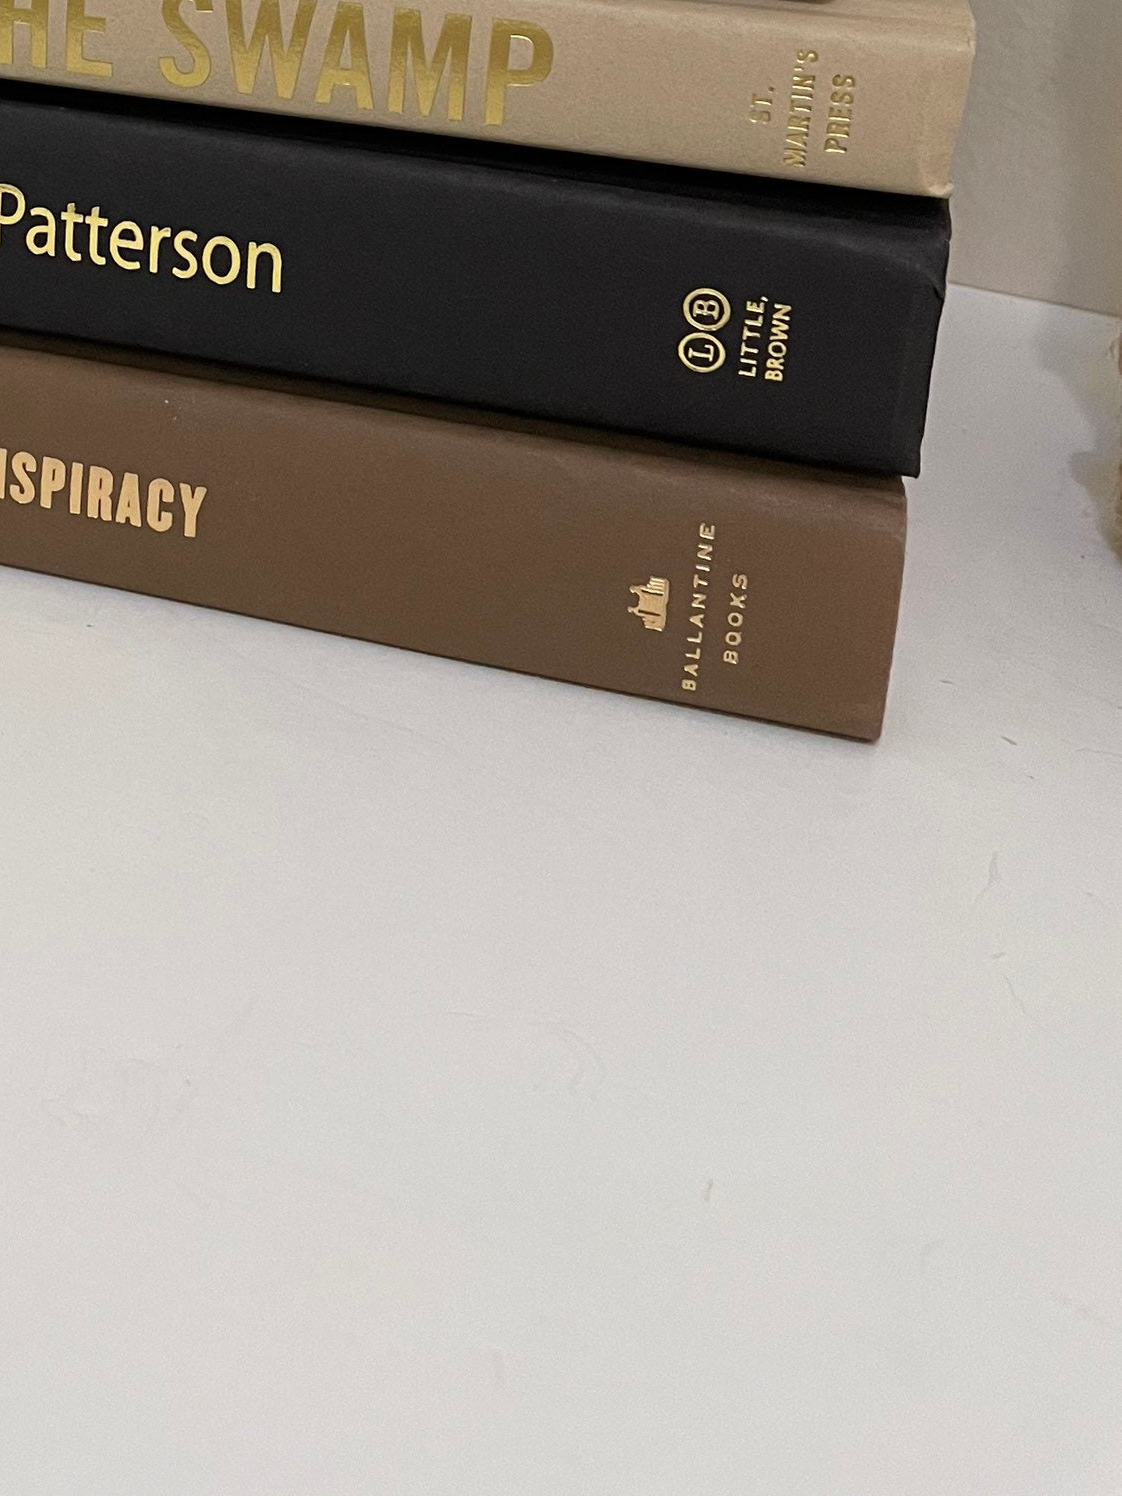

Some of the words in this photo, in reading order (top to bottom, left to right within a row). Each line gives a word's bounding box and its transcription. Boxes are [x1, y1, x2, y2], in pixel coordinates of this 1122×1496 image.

[748, 85, 775, 125] ST.
[783, 49, 819, 167] MARTIN'S
[823, 73, 856, 154] PRESS
[738, 296, 768, 378] LITTLE,
[765, 303, 792, 382] BROWN
[681, 522, 716, 692] BALLANTINE
[723, 573, 748, 665] BOOKS
